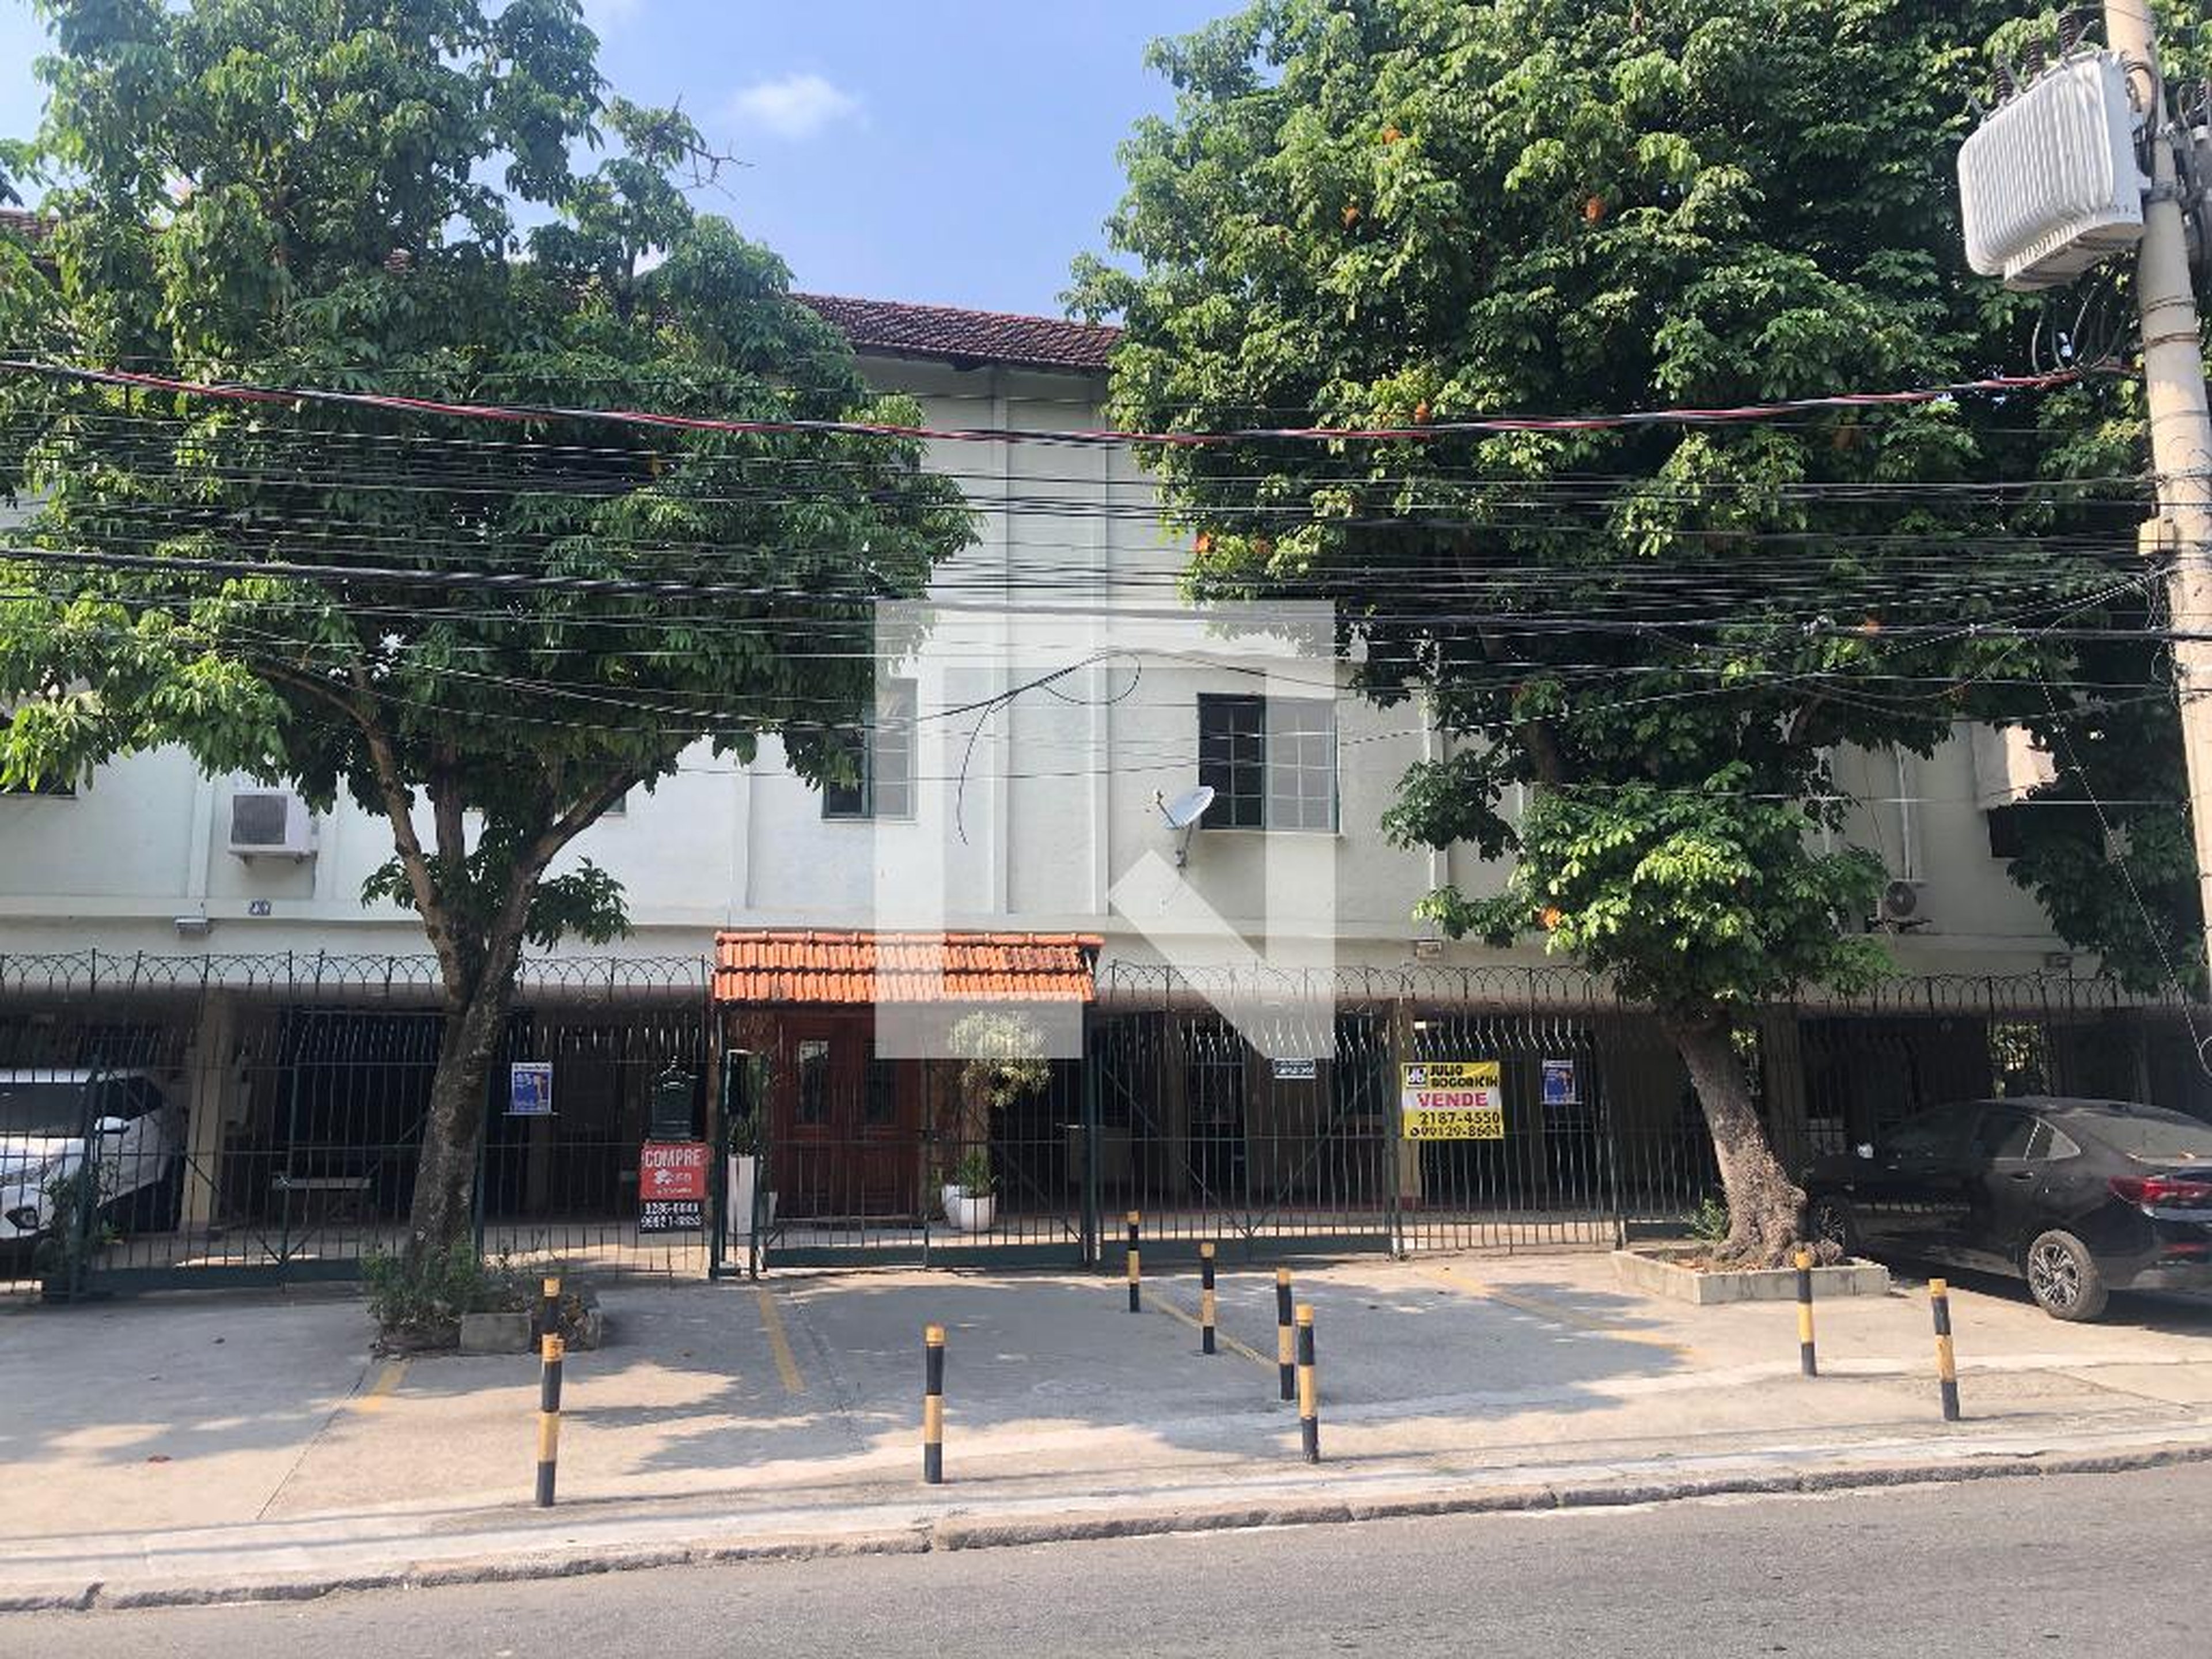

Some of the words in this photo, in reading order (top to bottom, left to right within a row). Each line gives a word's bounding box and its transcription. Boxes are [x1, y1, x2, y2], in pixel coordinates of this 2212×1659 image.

[1430, 1065, 1463, 1076] JULIO
[1417, 1093, 1488, 1107] VENDE
[1419, 1112, 1500, 1125] 2187-4550
[645, 1148, 702, 1167] COMPRE
